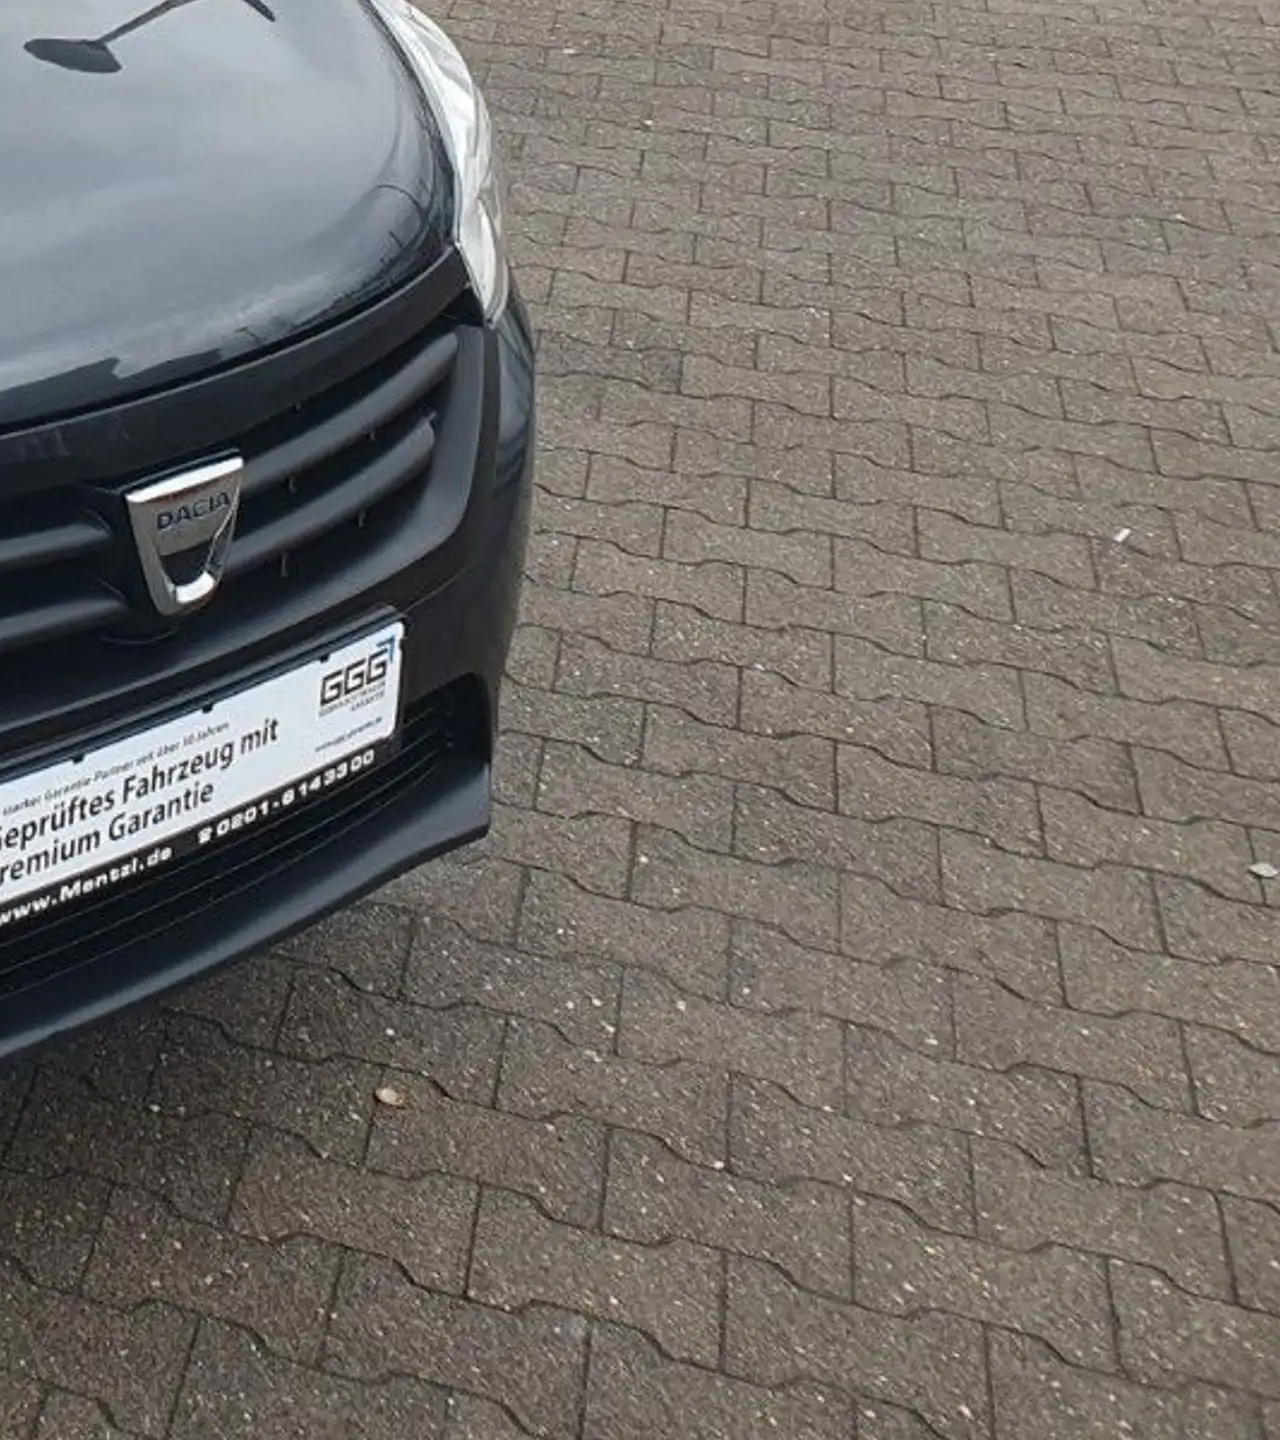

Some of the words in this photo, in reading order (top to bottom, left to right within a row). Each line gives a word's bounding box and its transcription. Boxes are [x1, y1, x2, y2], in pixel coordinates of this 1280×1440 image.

[156, 491, 230, 531] DACIA
[319, 647, 389, 707] GGG
[122, 739, 235, 804] Fahrzeug
[240, 717, 279, 755] mit
[108, 780, 214, 841] Garantie
